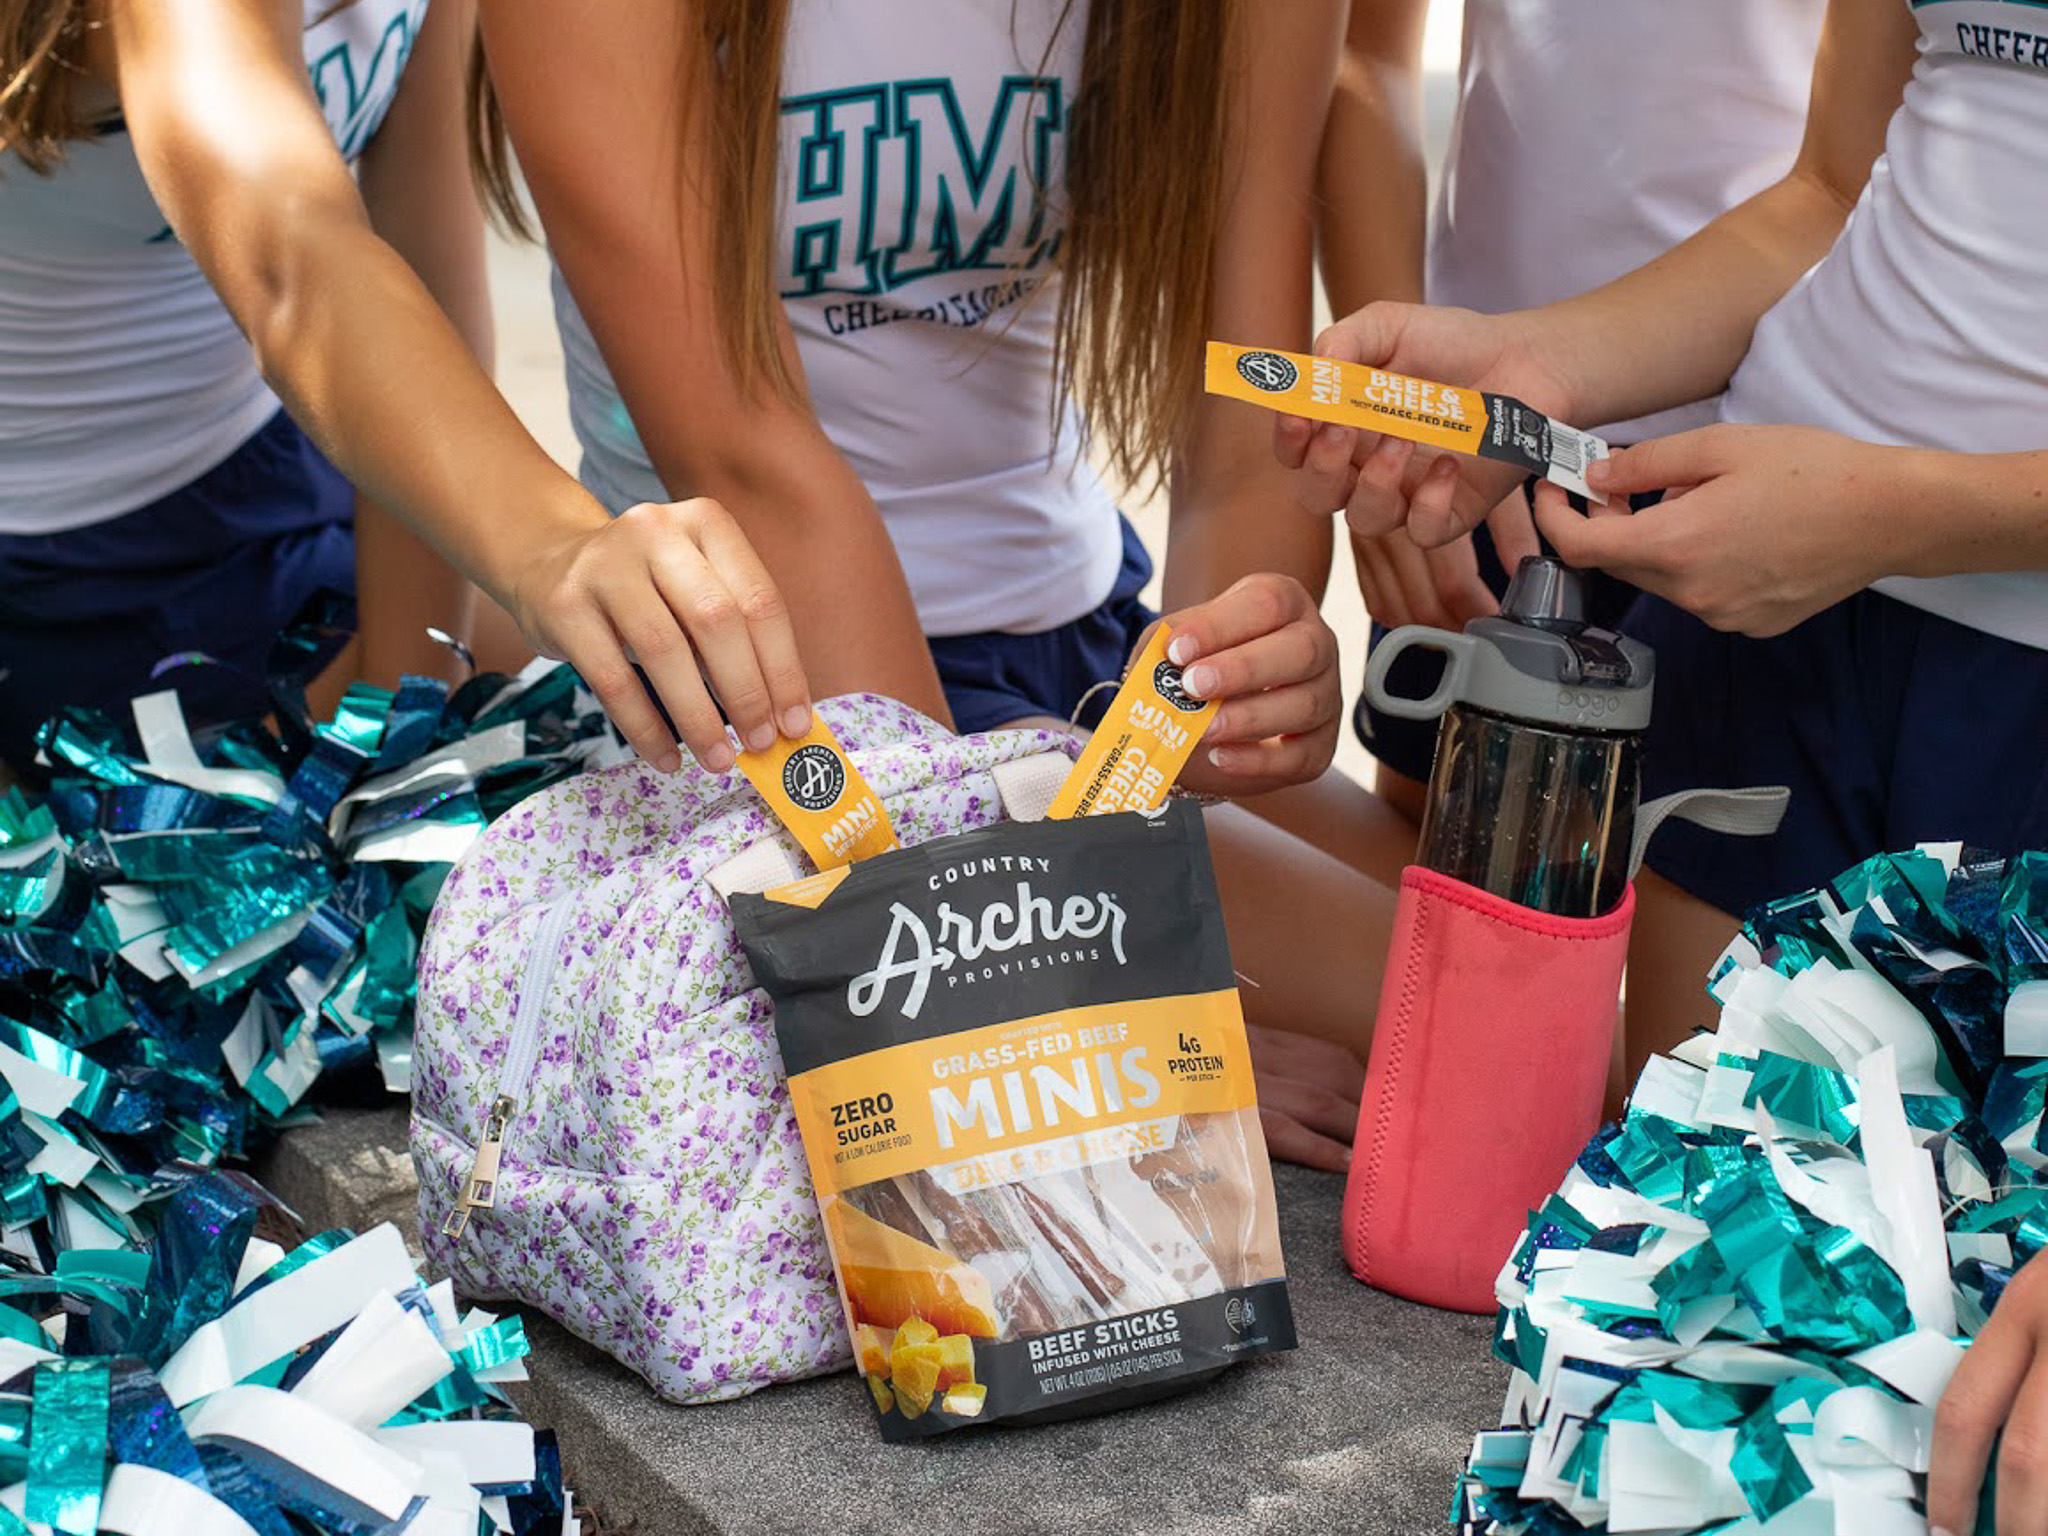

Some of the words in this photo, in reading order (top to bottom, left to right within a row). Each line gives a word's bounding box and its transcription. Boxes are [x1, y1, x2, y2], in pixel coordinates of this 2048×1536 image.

[778, 76, 1070, 295] HM
[1311, 359, 1331, 404] MINI
[1365, 385, 1465, 421] CHEESE
[1370, 371, 1436, 397] BEEF
[1440, 388, 1461, 405] &
[1372, 404, 1440, 426] GRASS-FED
[1442, 420, 1473, 433] BEEF
[1131, 699, 1189, 748] MINI
[1086, 748, 1122, 801] GRASS-FED
[1092, 746, 1147, 817] CHEES
[1123, 764, 1164, 812] BEE
[820, 796, 875, 853] MINI
[928, 856, 1051, 891] COUNTRY
[847, 881, 1128, 1020] Archer
[948, 949, 1100, 988] PROVISIONS
[932, 1032, 1072, 1079] GRASS-FED
[1078, 1022, 1129, 1048] BEEF
[1168, 1055, 1225, 1075] PROTEIN
[1179, 1033, 1201, 1053] 4G
[831, 1092, 894, 1128] ZERO
[929, 1047, 1162, 1150] MINIS
[837, 1118, 897, 1147] SUGAR
[1028, 1329, 1087, 1361] BEEF
[1094, 1308, 1179, 1344] STICKS
[1032, 1351, 1090, 1375] INFUSED
[1093, 1342, 1129, 1360] WITH
[1132, 1330, 1181, 1352] CHEESE
